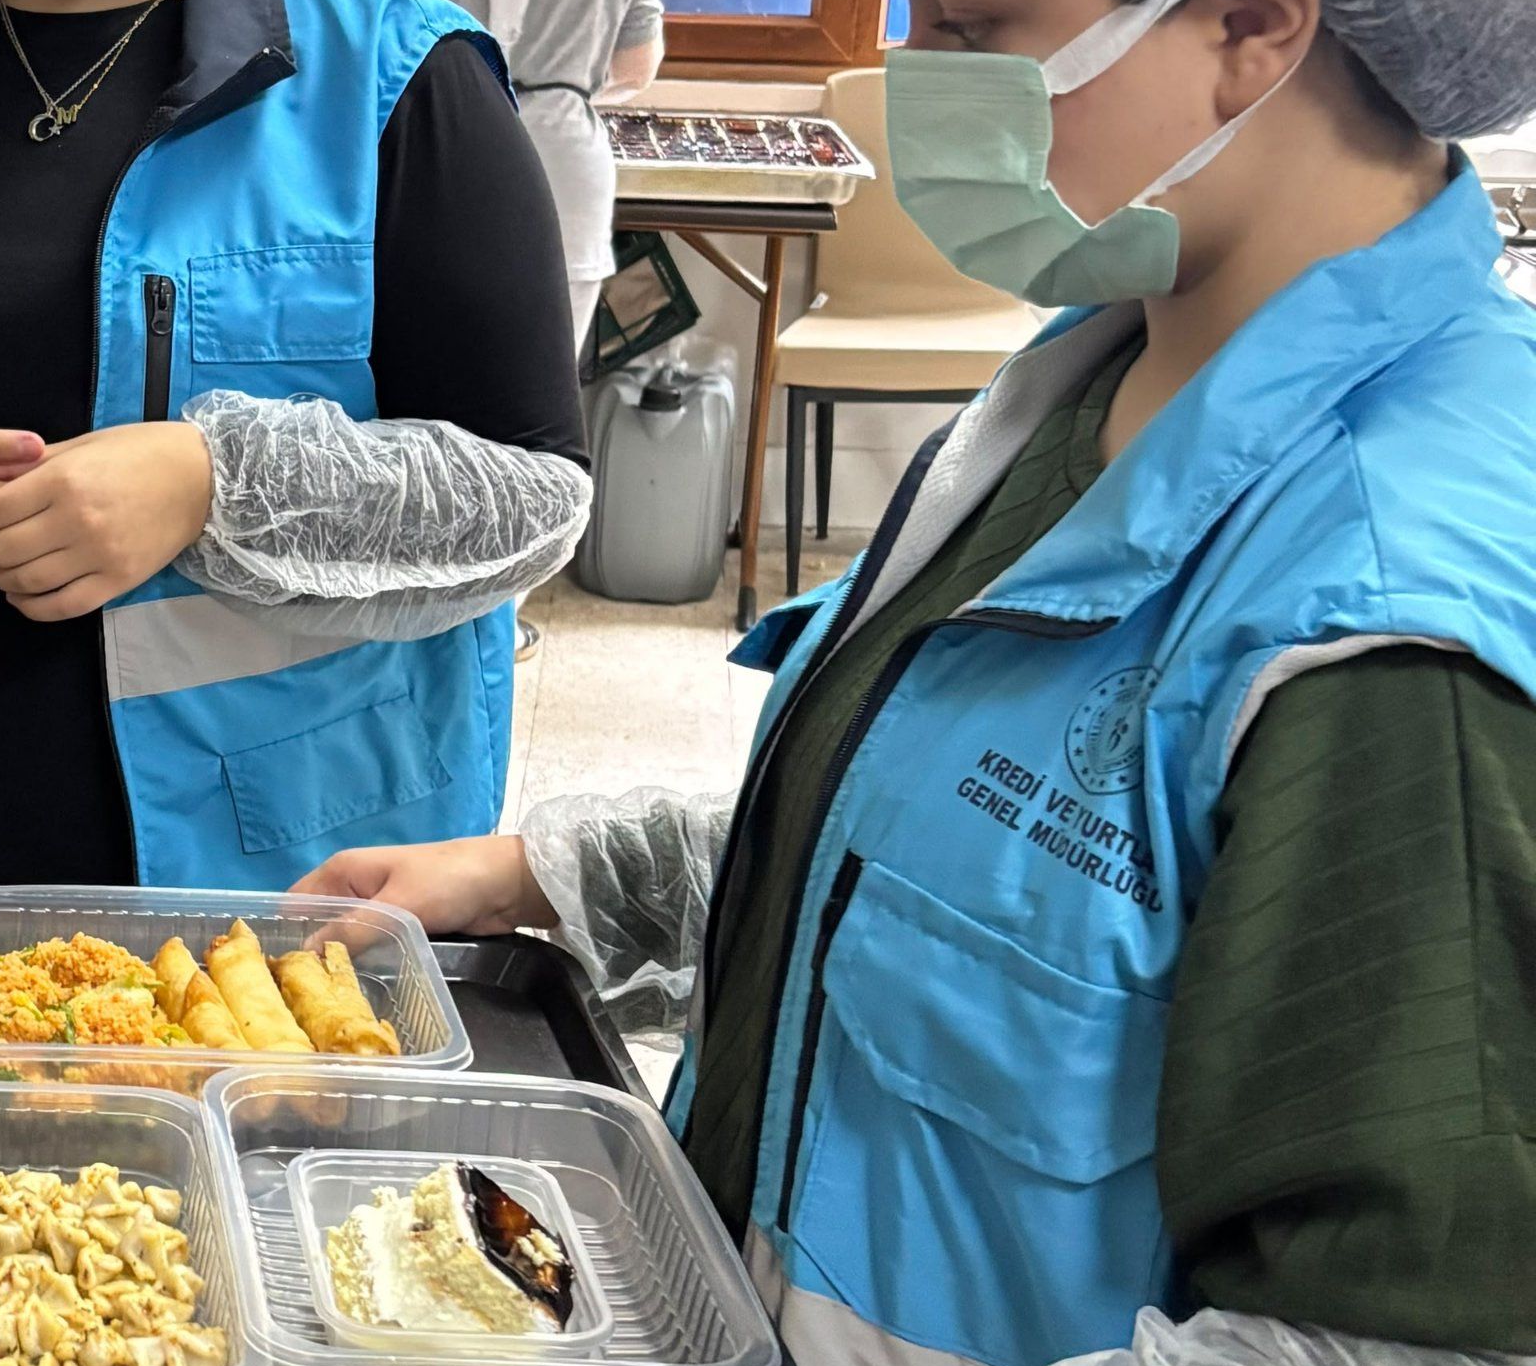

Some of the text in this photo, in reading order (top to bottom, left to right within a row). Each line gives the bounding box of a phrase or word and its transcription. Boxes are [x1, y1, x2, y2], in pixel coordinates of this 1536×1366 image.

[956, 777, 1023, 832] GENEL
[976, 749, 1157, 875] KREDİ VE YURTLA
